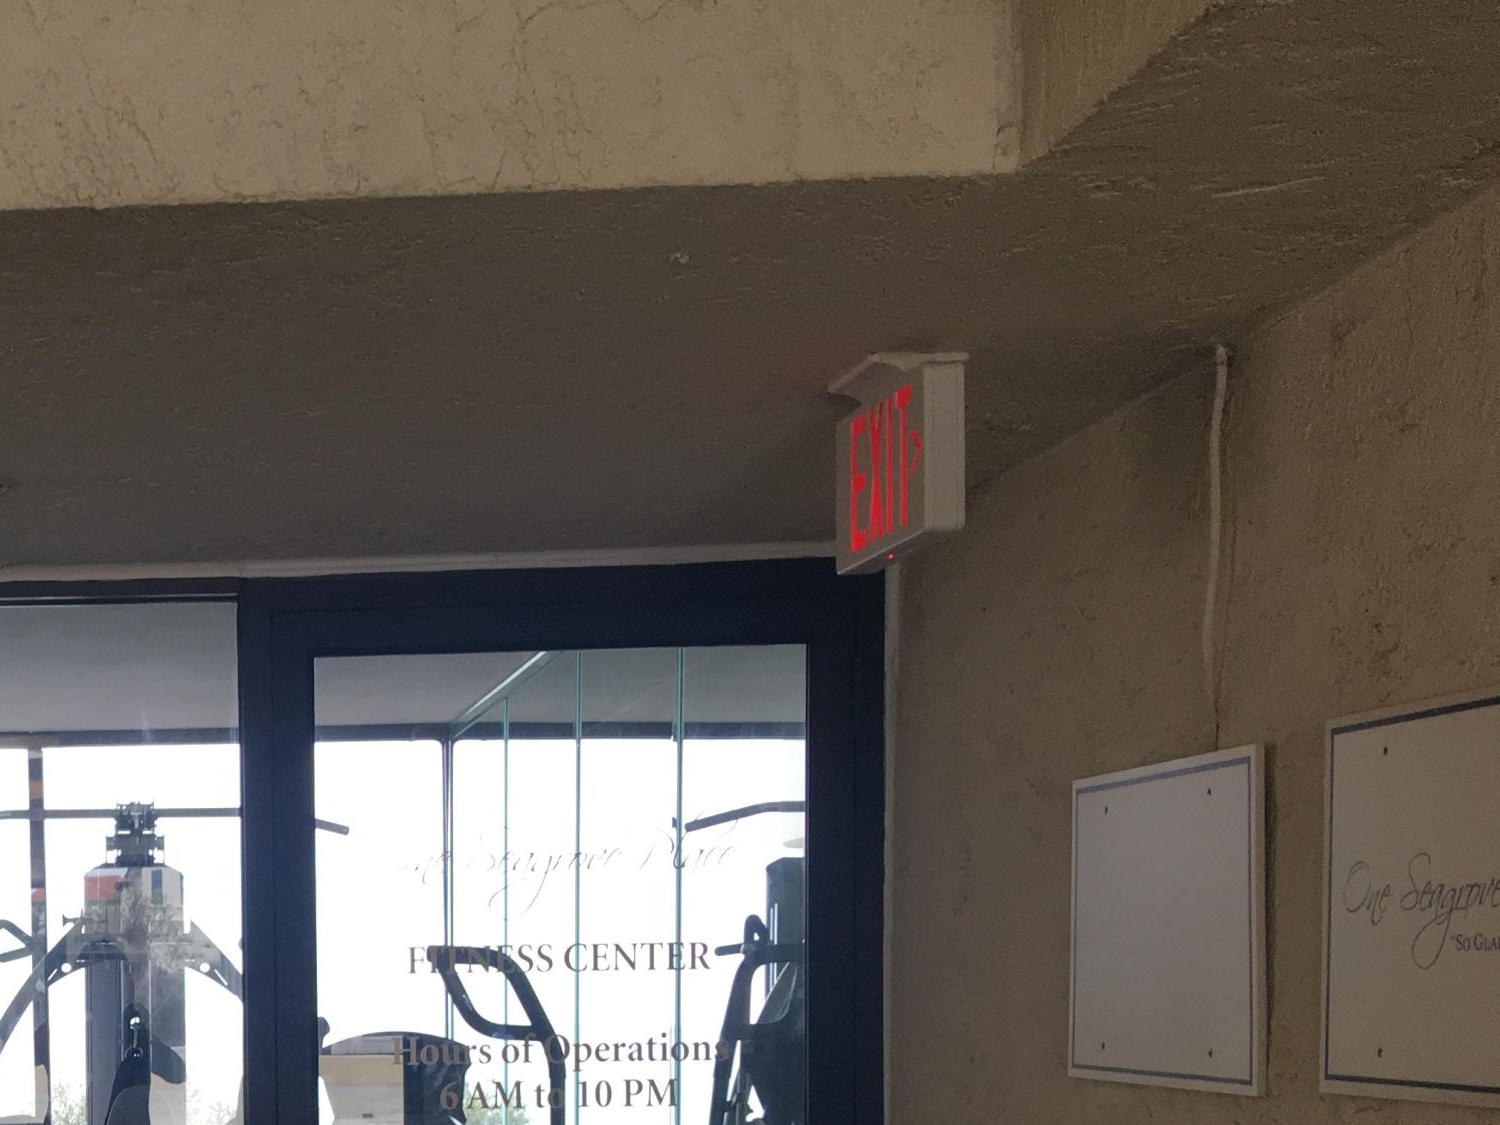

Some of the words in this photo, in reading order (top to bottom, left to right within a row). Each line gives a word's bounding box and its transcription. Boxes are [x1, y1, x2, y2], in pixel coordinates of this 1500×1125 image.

[850, 383, 913, 554] EXIT
[1342, 860, 1394, 926] One
[1399, 852, 1500, 969] Seagrove
[408, 943, 554, 975] FITNESS
[563, 941, 712, 973] CENTER
[391, 1034, 492, 1067] Hours
[501, 1032, 538, 1064] of
[543, 1032, 730, 1072] Operations
[439, 1081, 460, 1110] 6
[466, 1080, 524, 1109] AM
[534, 1083, 565, 1109] to
[578, 1080, 613, 1108] 10
[623, 1078, 679, 1108] PM
